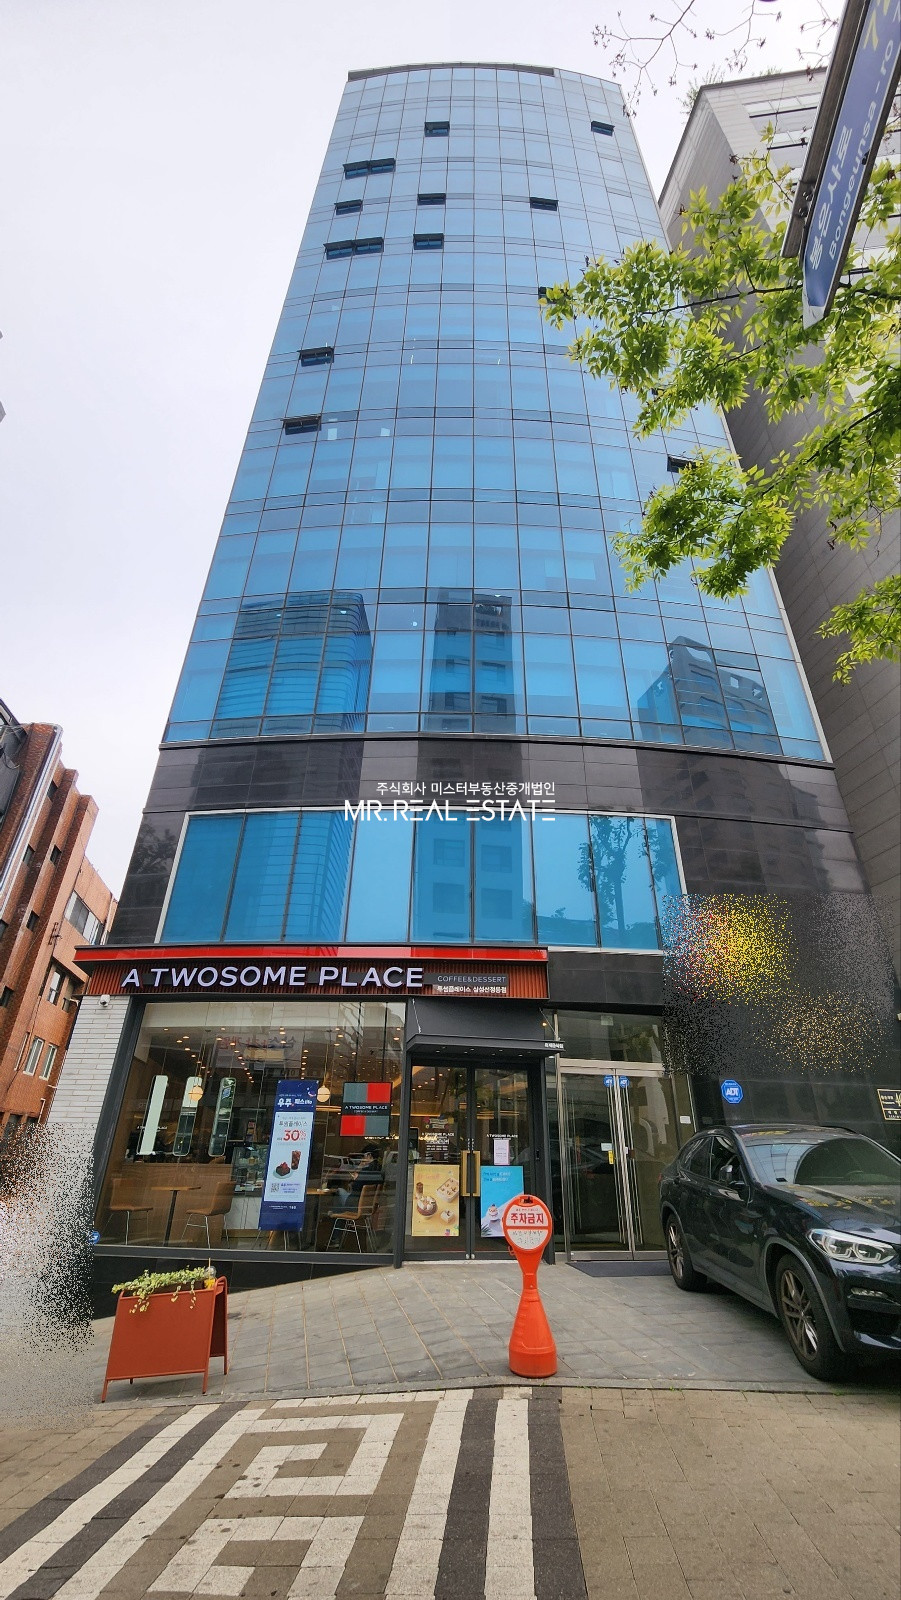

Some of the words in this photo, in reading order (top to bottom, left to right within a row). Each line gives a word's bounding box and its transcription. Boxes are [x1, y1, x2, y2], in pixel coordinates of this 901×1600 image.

[809, 125, 852, 271] 봉은사로
[121, 967, 141, 988] A
[150, 966, 307, 987] TWOSOME
[318, 966, 425, 988] PLACE
[437, 975, 506, 983] COFFEE&DESSERT
[726, 1087, 739, 1096] ADT
[283, 1129, 307, 1141] 30%
[510, 1212, 544, 1224] 주차금지
